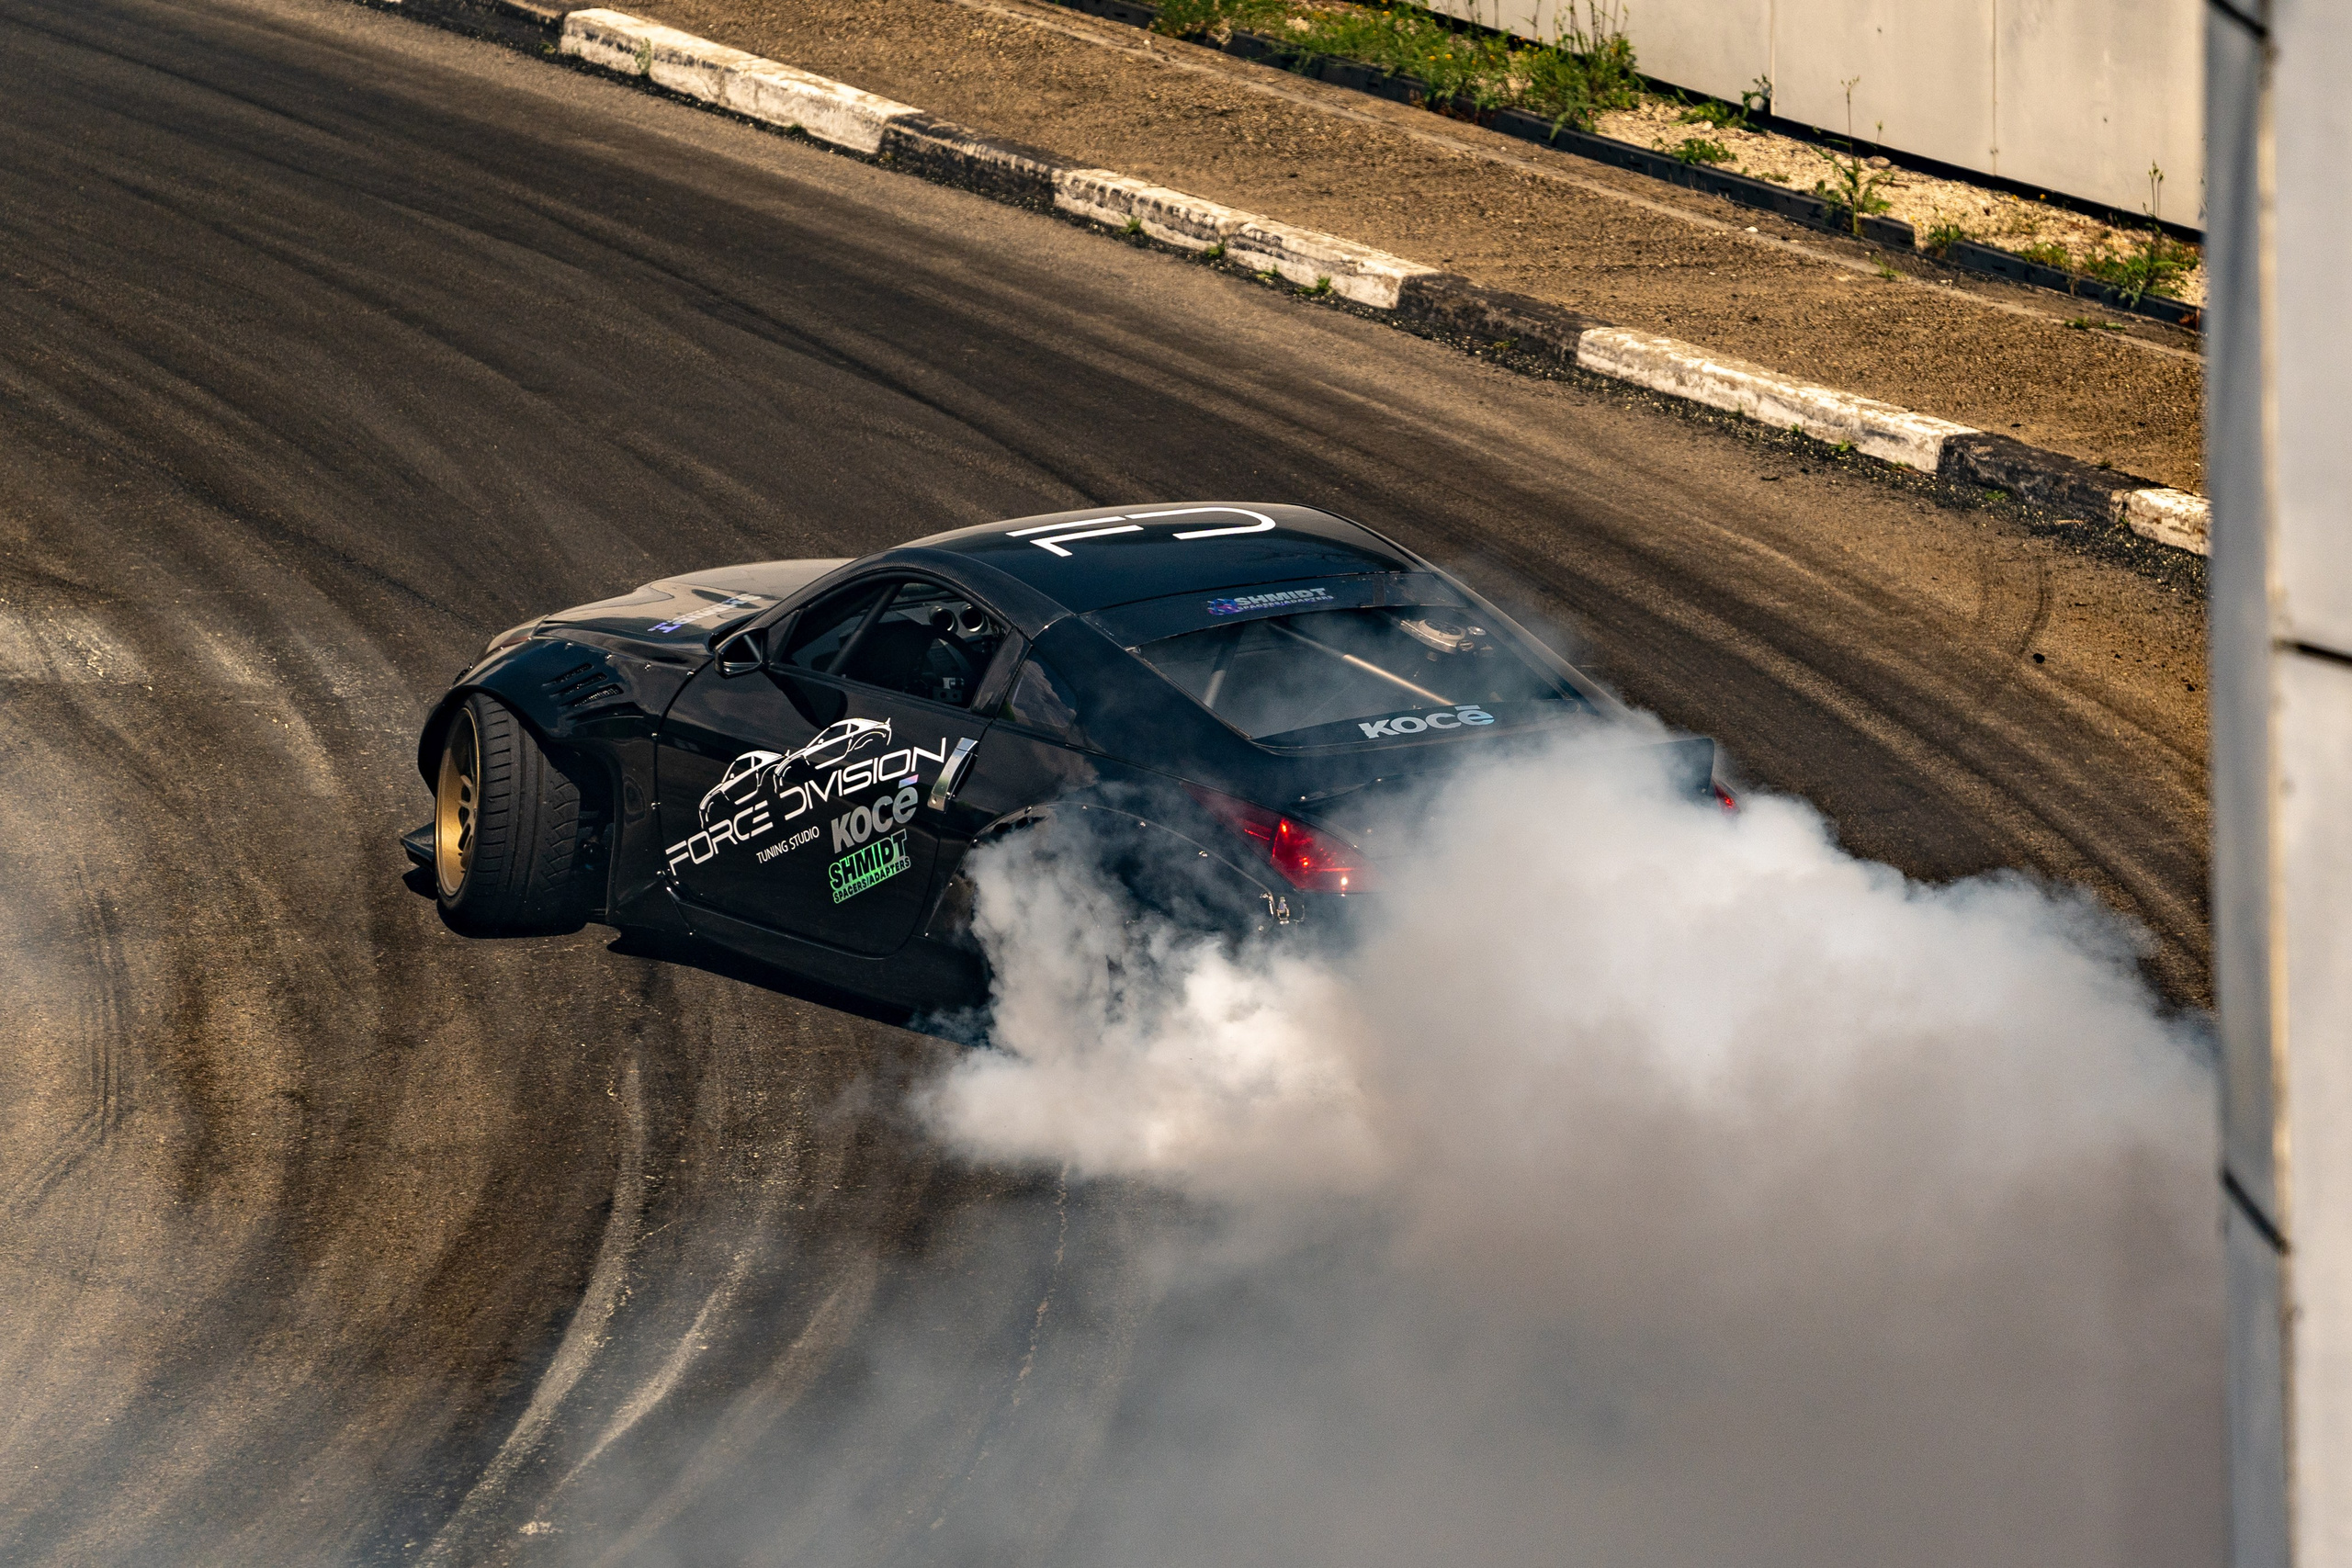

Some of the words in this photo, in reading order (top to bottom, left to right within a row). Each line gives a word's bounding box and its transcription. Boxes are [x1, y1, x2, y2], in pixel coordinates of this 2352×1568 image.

[1233, 587, 1327, 606] SHMIDT
[665, 800, 774, 876] FORCE
[779, 737, 947, 821] DIVISION
[755, 840, 789, 864] TUNING
[790, 826, 820, 851] STUDIO
[829, 829, 908, 890] SHMIDT
[832, 855, 911, 905] SPACERS/ADAPTERS
